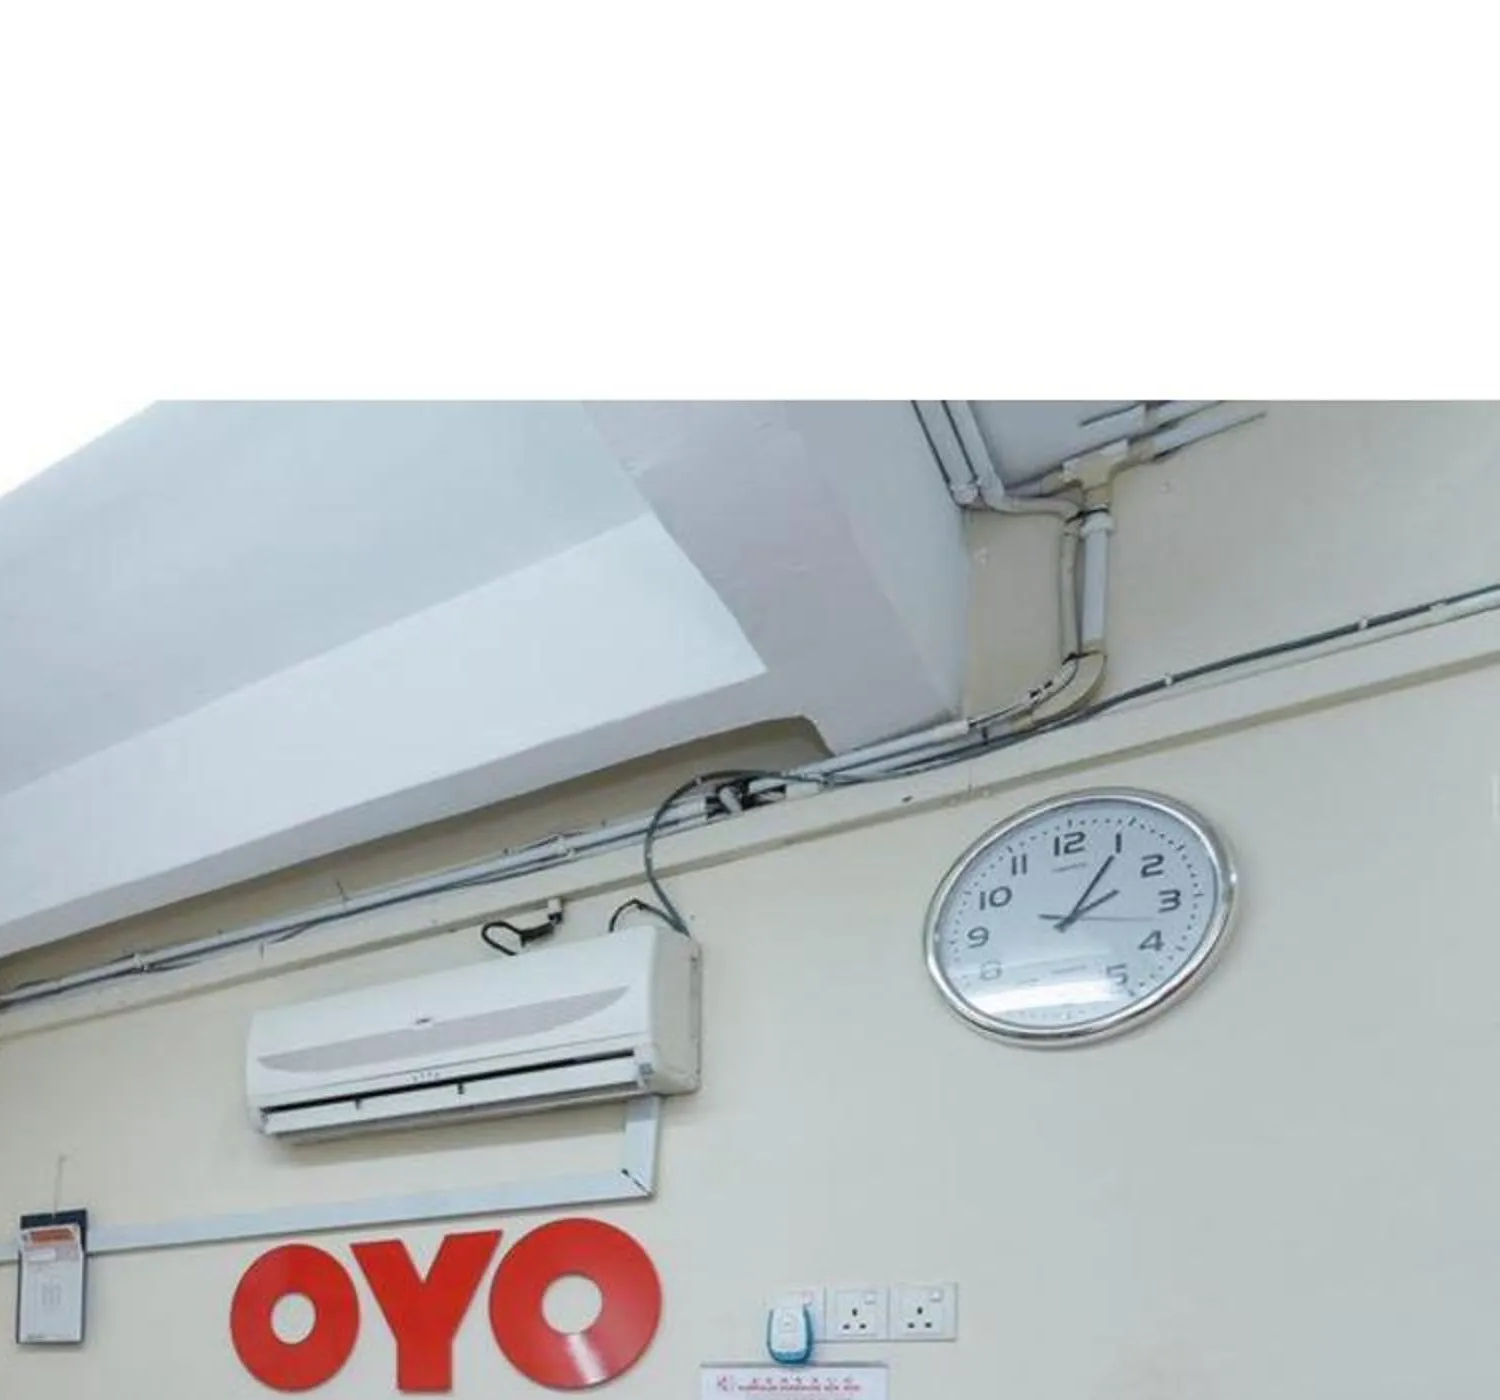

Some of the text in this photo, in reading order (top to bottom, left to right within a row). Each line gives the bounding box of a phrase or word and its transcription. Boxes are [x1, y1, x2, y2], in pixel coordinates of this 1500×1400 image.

[1052, 831, 1087, 857] 12
[1114, 832, 1123, 853] 1
[1010, 853, 1029, 876] 11
[1140, 853, 1165, 878] 2
[979, 886, 1013, 910] 10
[1157, 889, 1182, 913] 3
[966, 926, 990, 949] 9
[1137, 930, 1166, 951] 4
[1105, 963, 1128, 986] 5
[230, 1217, 663, 1393] OYO
